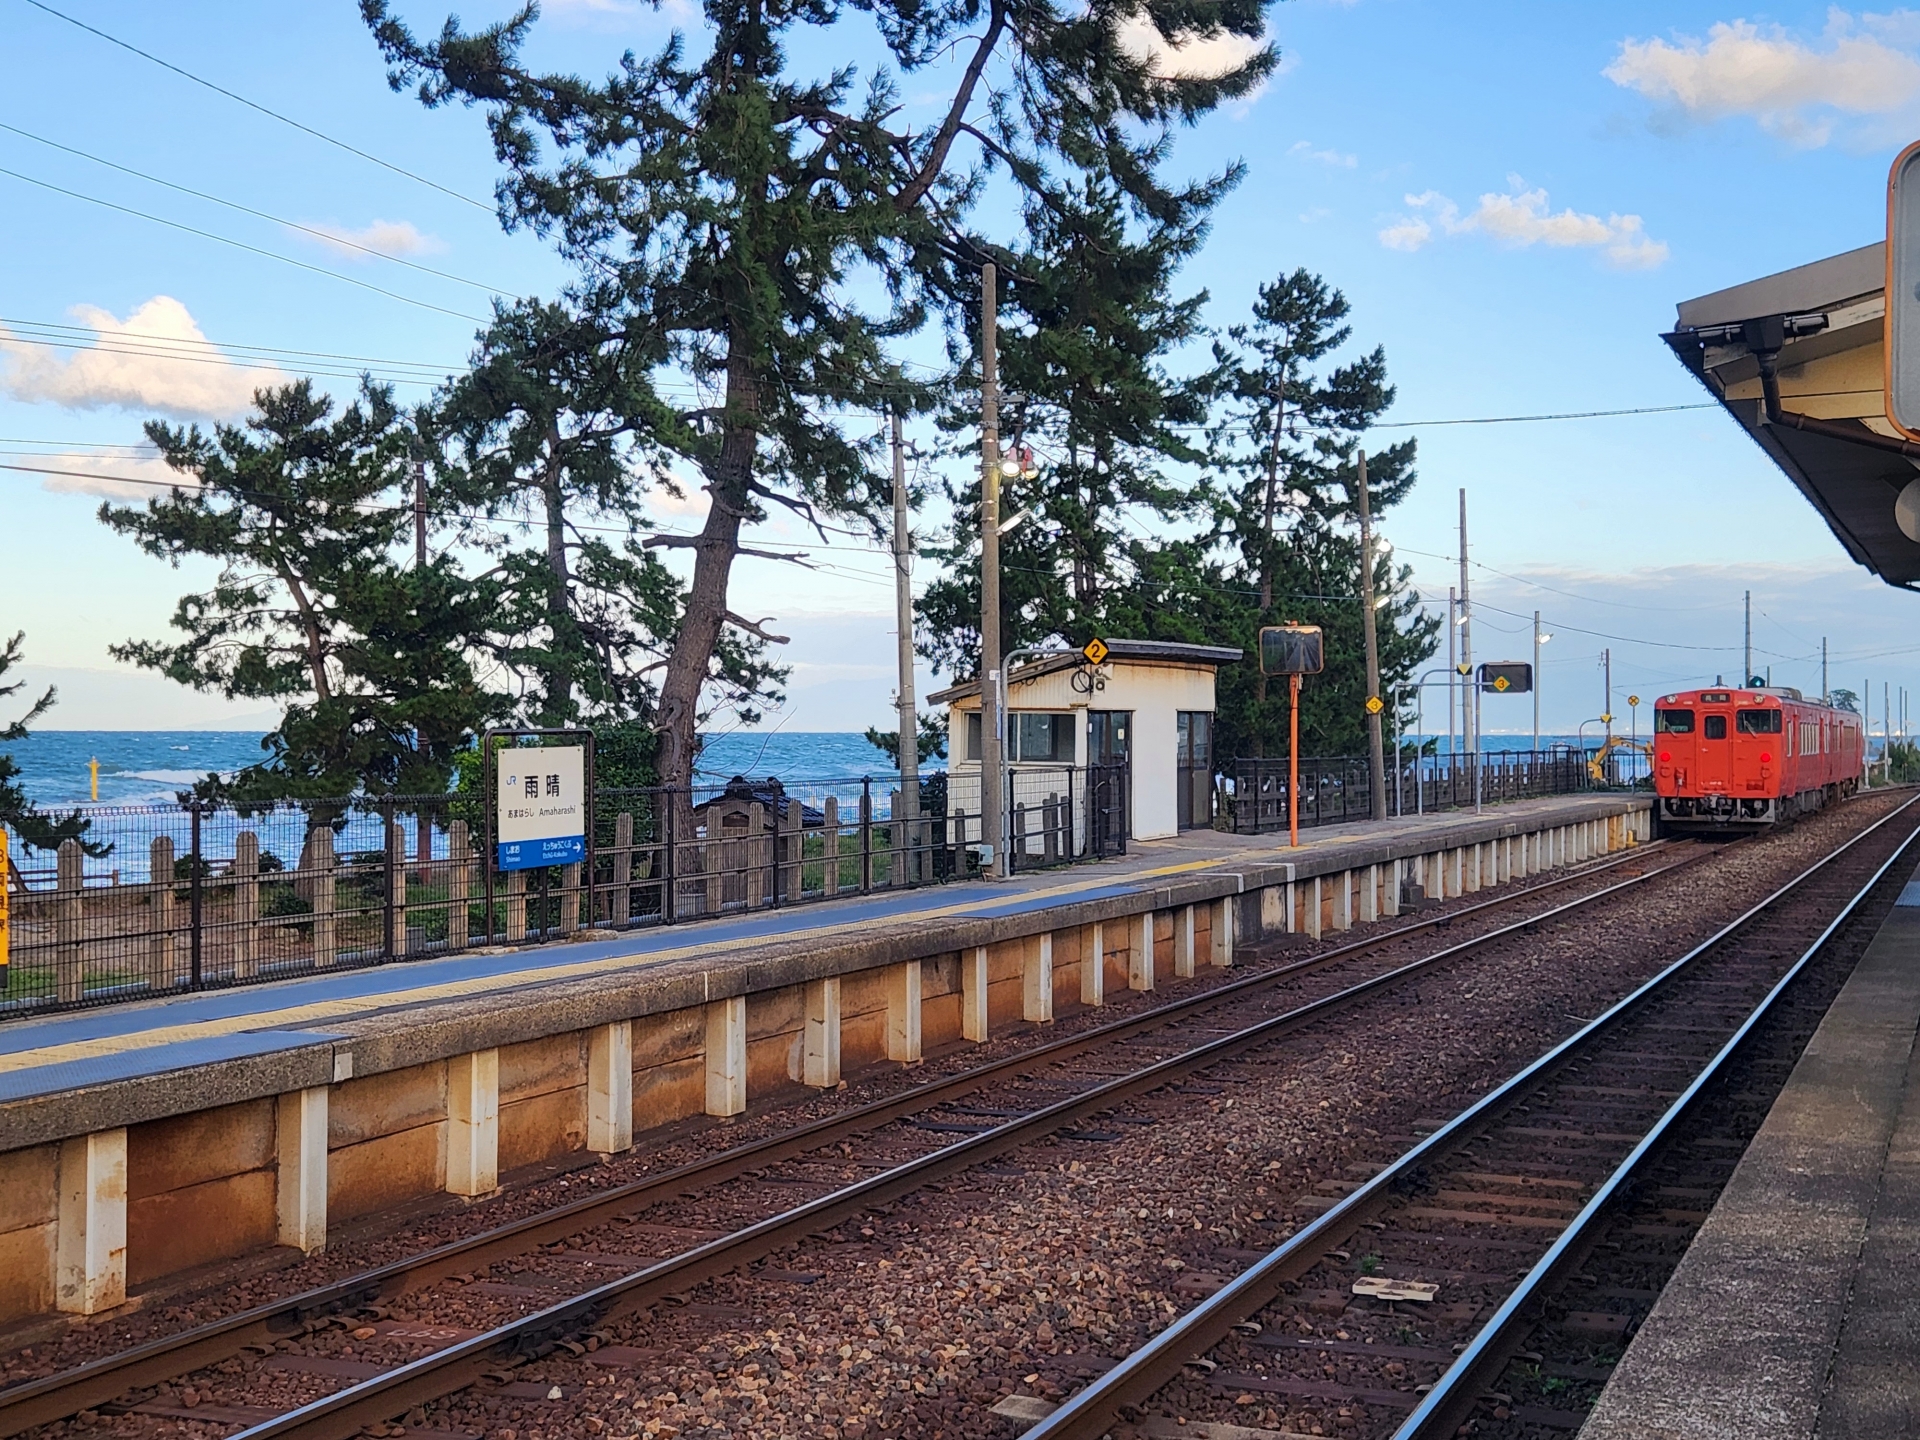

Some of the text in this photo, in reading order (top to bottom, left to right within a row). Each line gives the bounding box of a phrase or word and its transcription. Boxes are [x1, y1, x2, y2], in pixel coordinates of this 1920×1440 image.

[1091, 643, 1101, 659] 2
[1498, 679, 1505, 689] 3
[1370, 700, 1379, 710] 3
[506, 774, 560, 799] JR 雨晴
[507, 805, 576, 818] あまはらし Amaharashi
